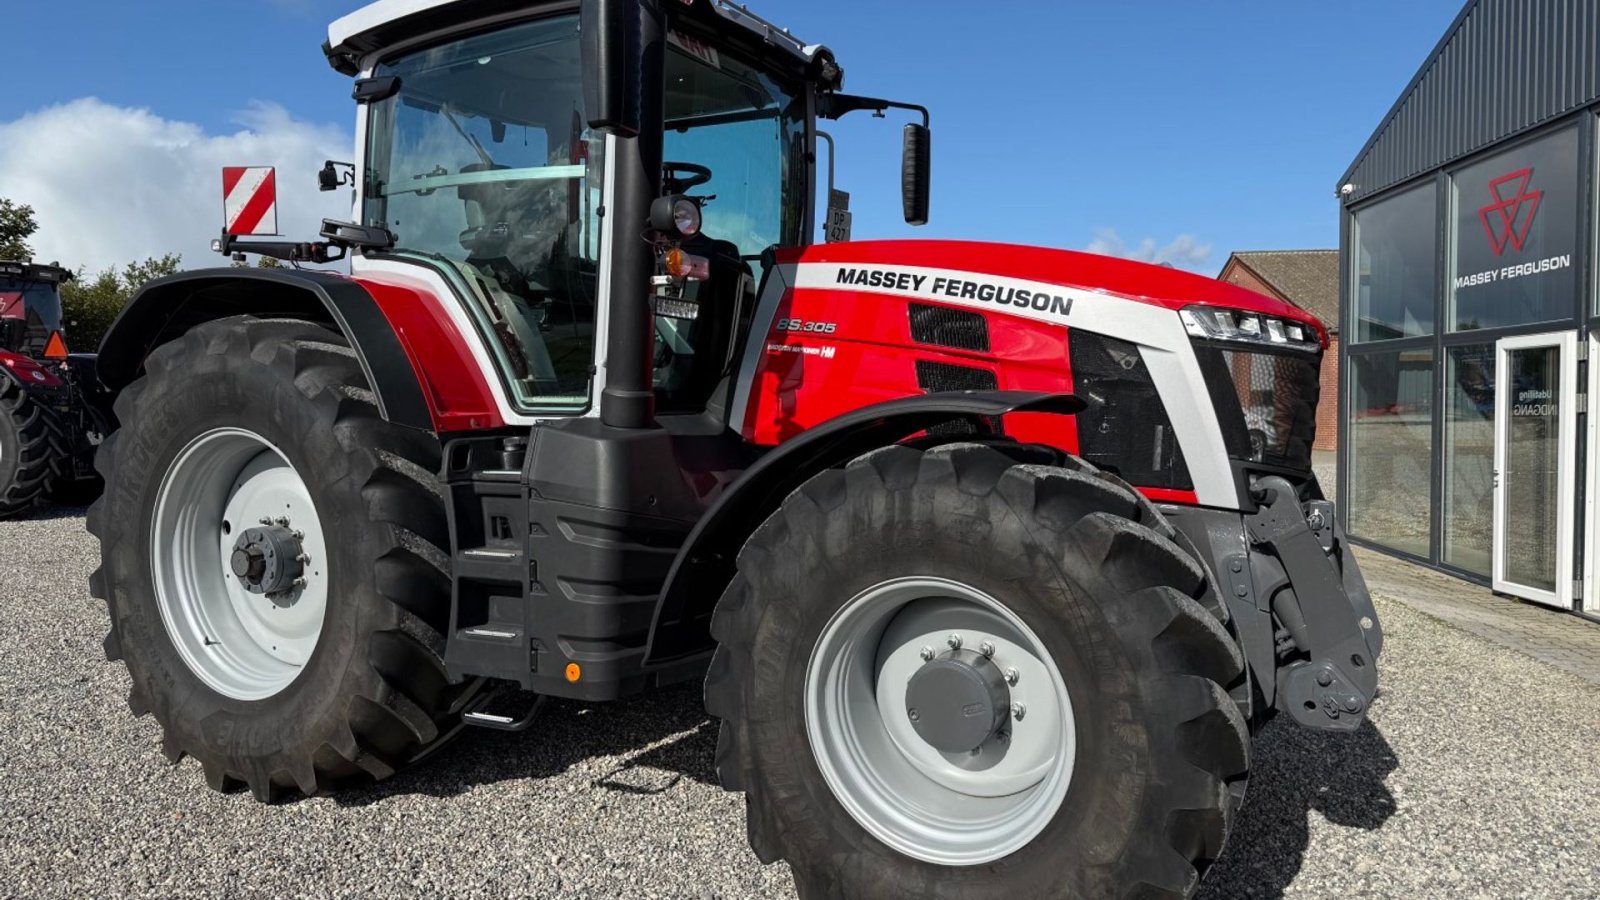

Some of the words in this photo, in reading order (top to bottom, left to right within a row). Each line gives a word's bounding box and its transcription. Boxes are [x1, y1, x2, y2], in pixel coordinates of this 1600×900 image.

[834, 212, 845, 226] DP
[831, 227, 846, 241] 427
[1454, 270, 1498, 290] MASSEY
[1500, 255, 1570, 280] FERGUSON
[837, 268, 927, 292] MASSEY
[932, 277, 1074, 316] FERGUSON
[776, 318, 837, 334] 8S.305
